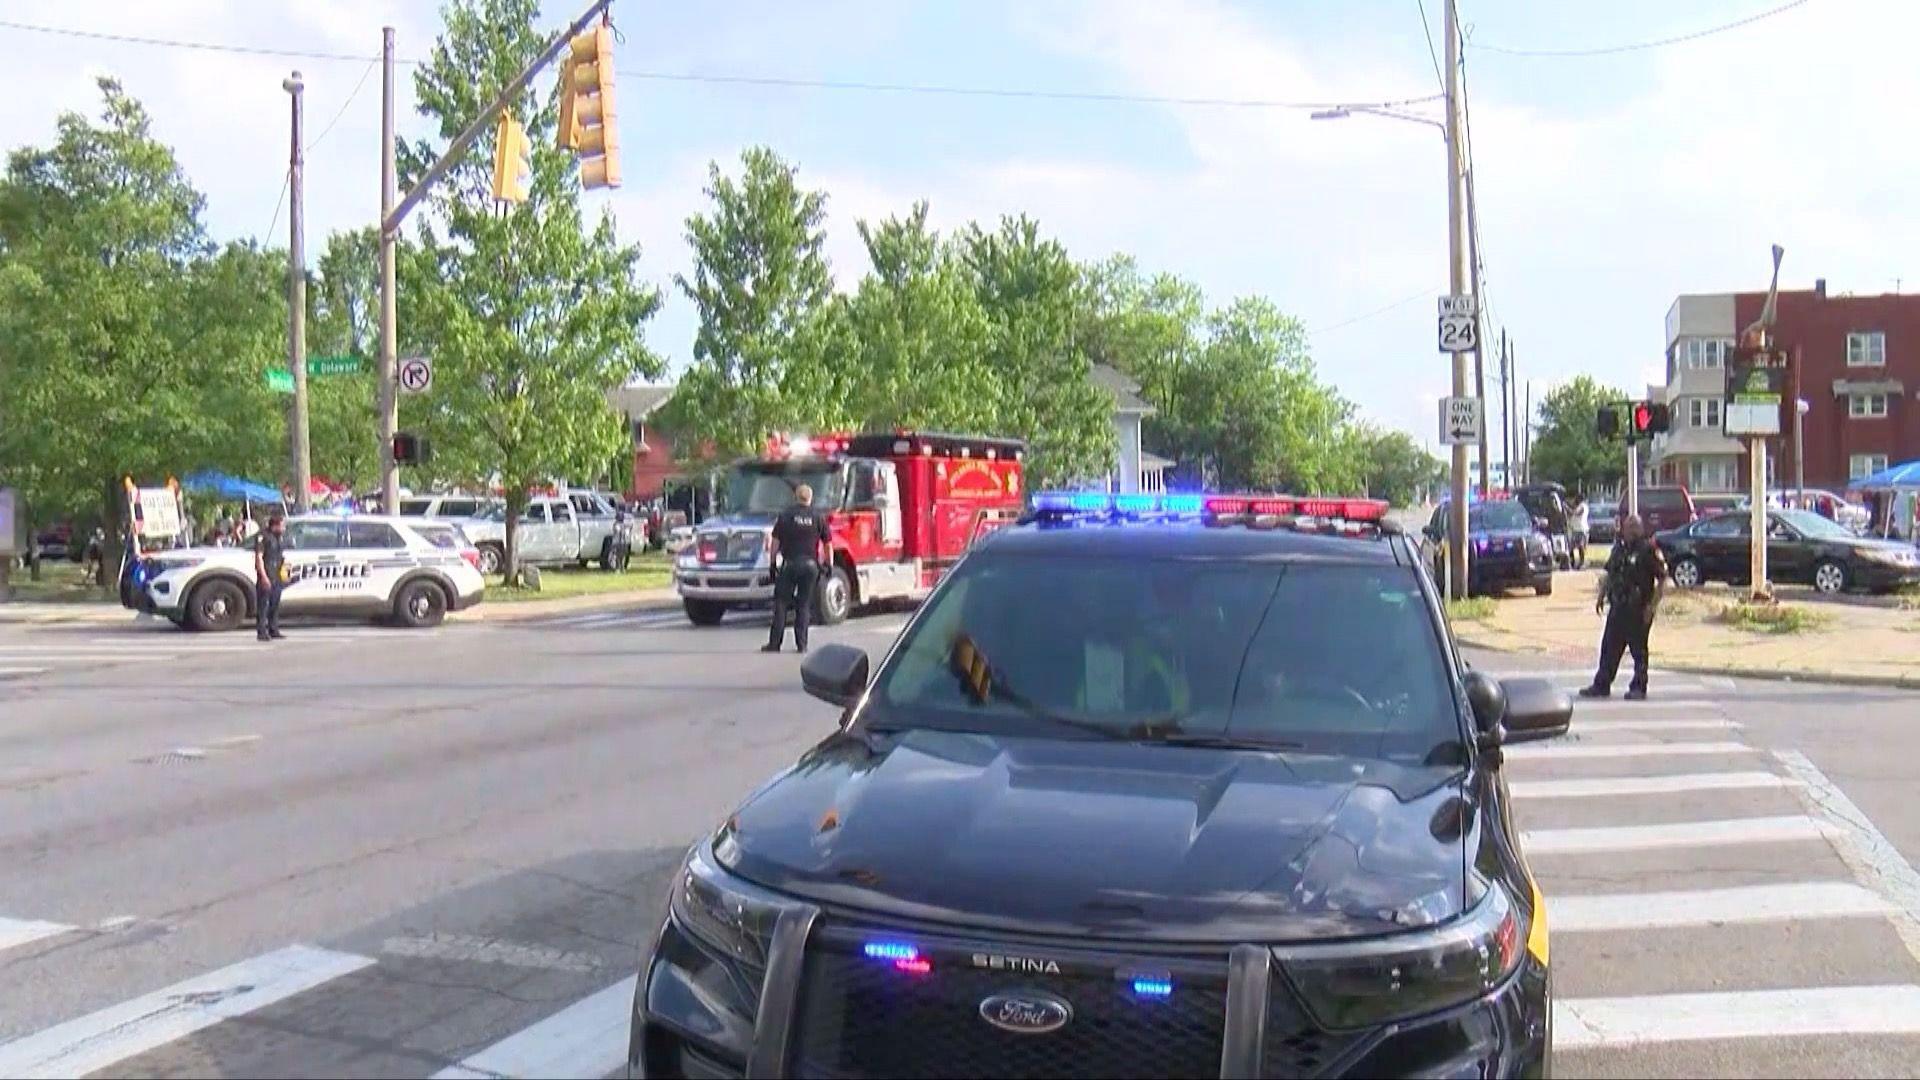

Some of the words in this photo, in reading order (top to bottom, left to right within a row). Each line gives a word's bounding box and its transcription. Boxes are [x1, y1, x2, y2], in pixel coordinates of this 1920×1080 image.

[1443, 299, 1471, 310] WEST
[1444, 323, 1472, 344] 24
[1452, 402, 1472, 412] ONE
[1451, 414, 1475, 426] WAY
[301, 563, 371, 579] POLICE
[972, 952, 1061, 975] SETINA
[999, 1000, 1047, 1025] Ford
